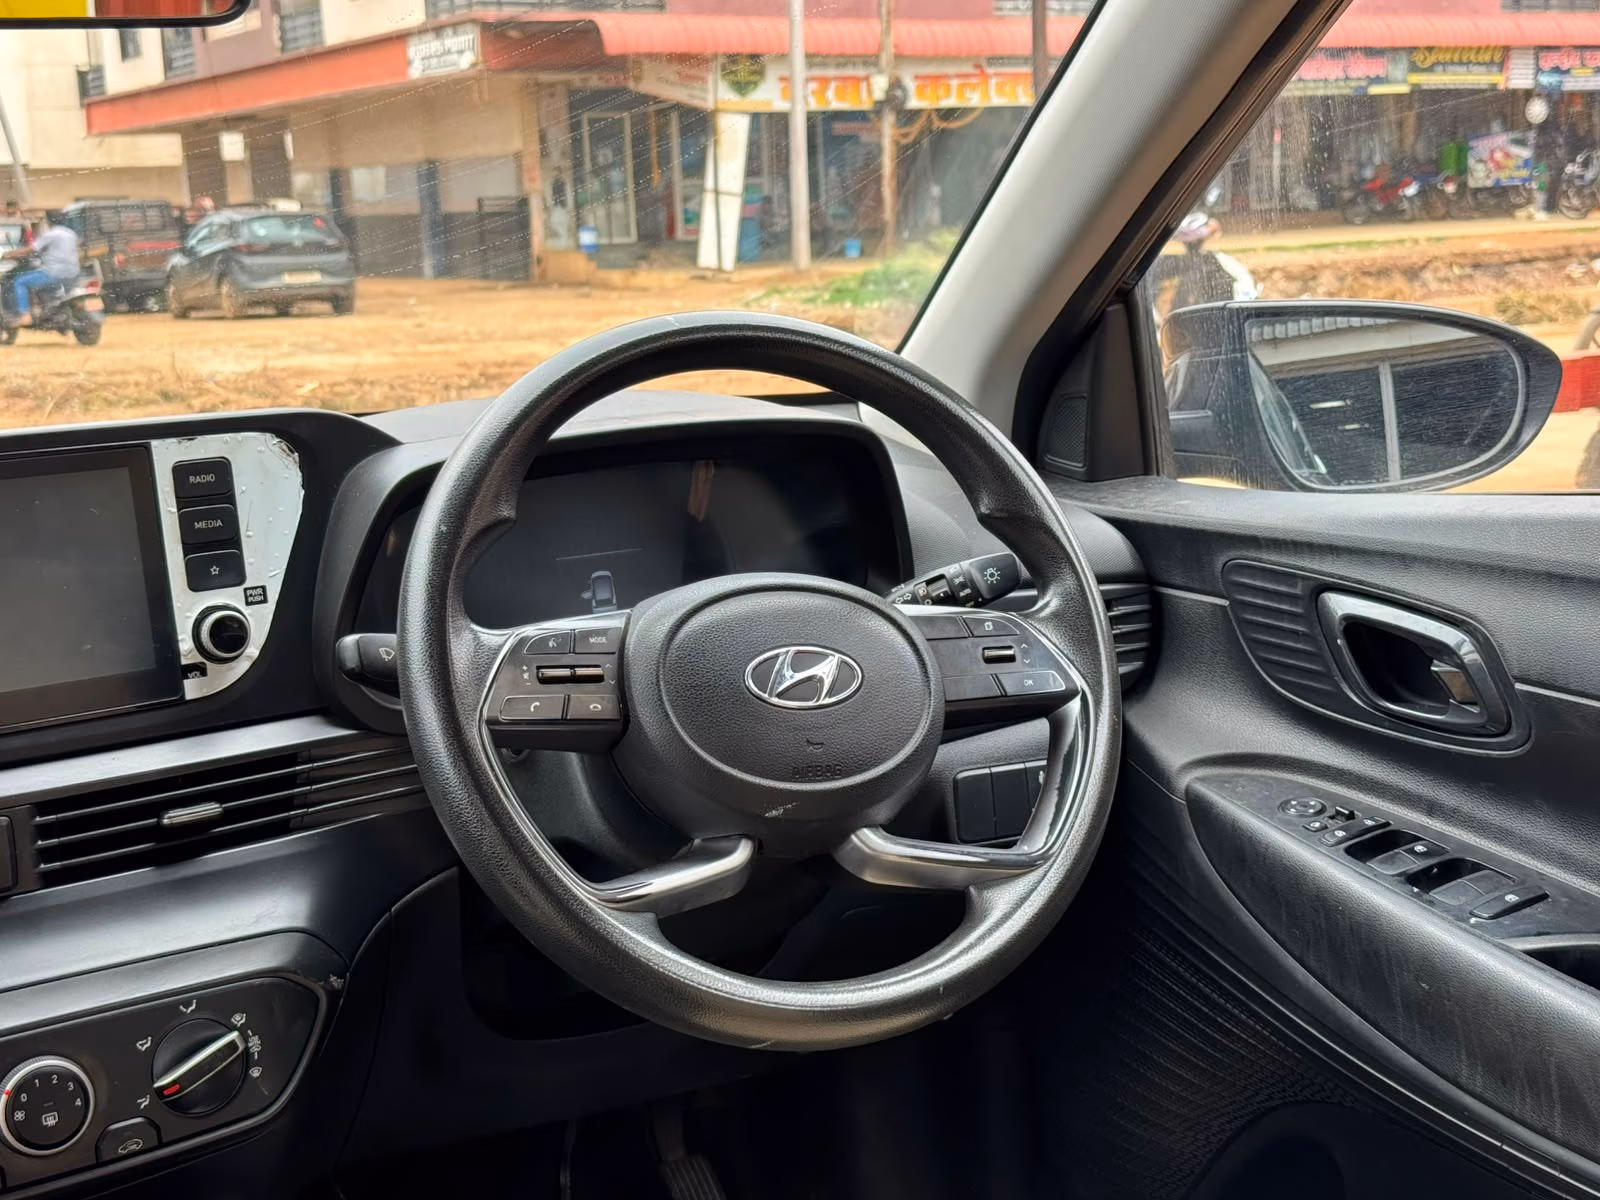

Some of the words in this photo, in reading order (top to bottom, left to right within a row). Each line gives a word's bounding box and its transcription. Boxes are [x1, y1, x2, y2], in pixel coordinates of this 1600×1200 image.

[189, 473, 216, 484] RADIO
[194, 519, 223, 530] MEDIA
[246, 588, 264, 597] PWR
[248, 595, 264, 603] PUSH
[1023, 679, 1034, 687] OK
[792, 764, 842, 779] AIRBAG
[20, 1093, 28, 1102] 0
[34, 1079, 40, 1087] 1
[51, 1074, 58, 1084] 2
[67, 1082, 74, 1091] 3
[74, 1097, 82, 1106] 4
